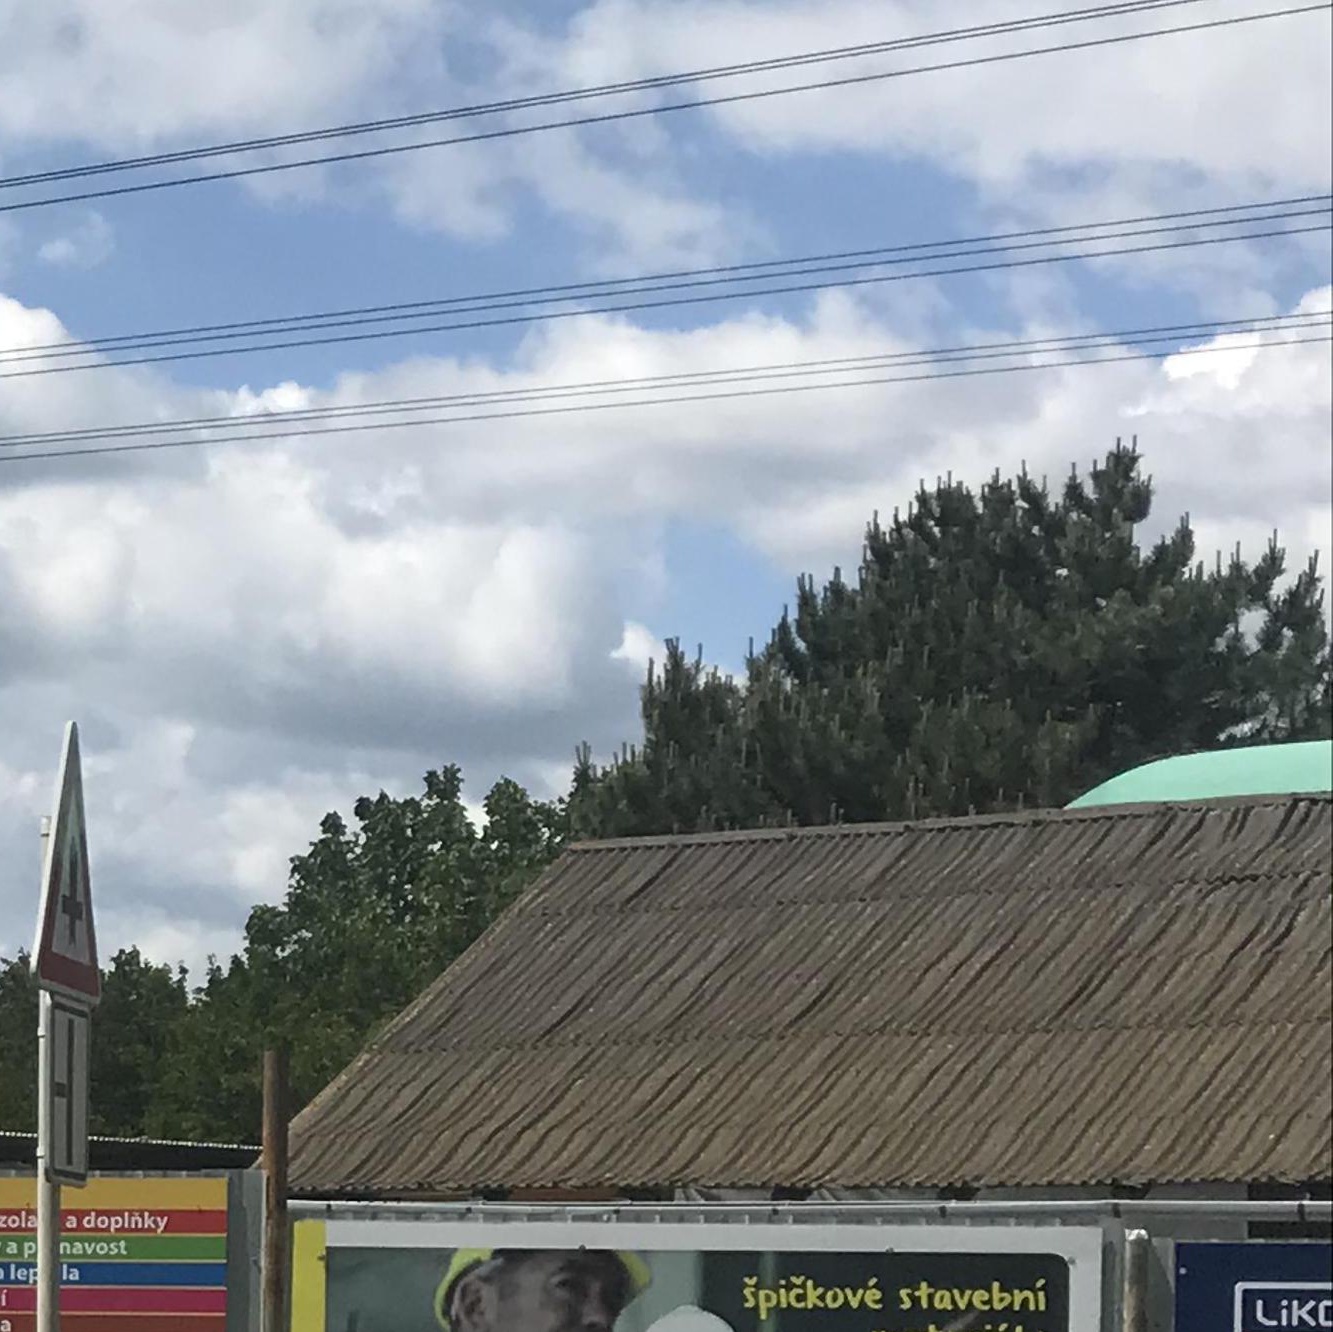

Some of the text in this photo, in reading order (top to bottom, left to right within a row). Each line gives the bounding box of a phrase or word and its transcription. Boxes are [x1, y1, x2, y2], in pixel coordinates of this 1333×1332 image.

[65, 1213, 78, 1229] a
[82, 1212, 169, 1235] doplňky
[5, 1240, 19, 1255] a
[23, 1239, 129, 1260] pnavost
[9, 1264, 81, 1286] lepla
[742, 1275, 1047, 1321] špičkové stavební
